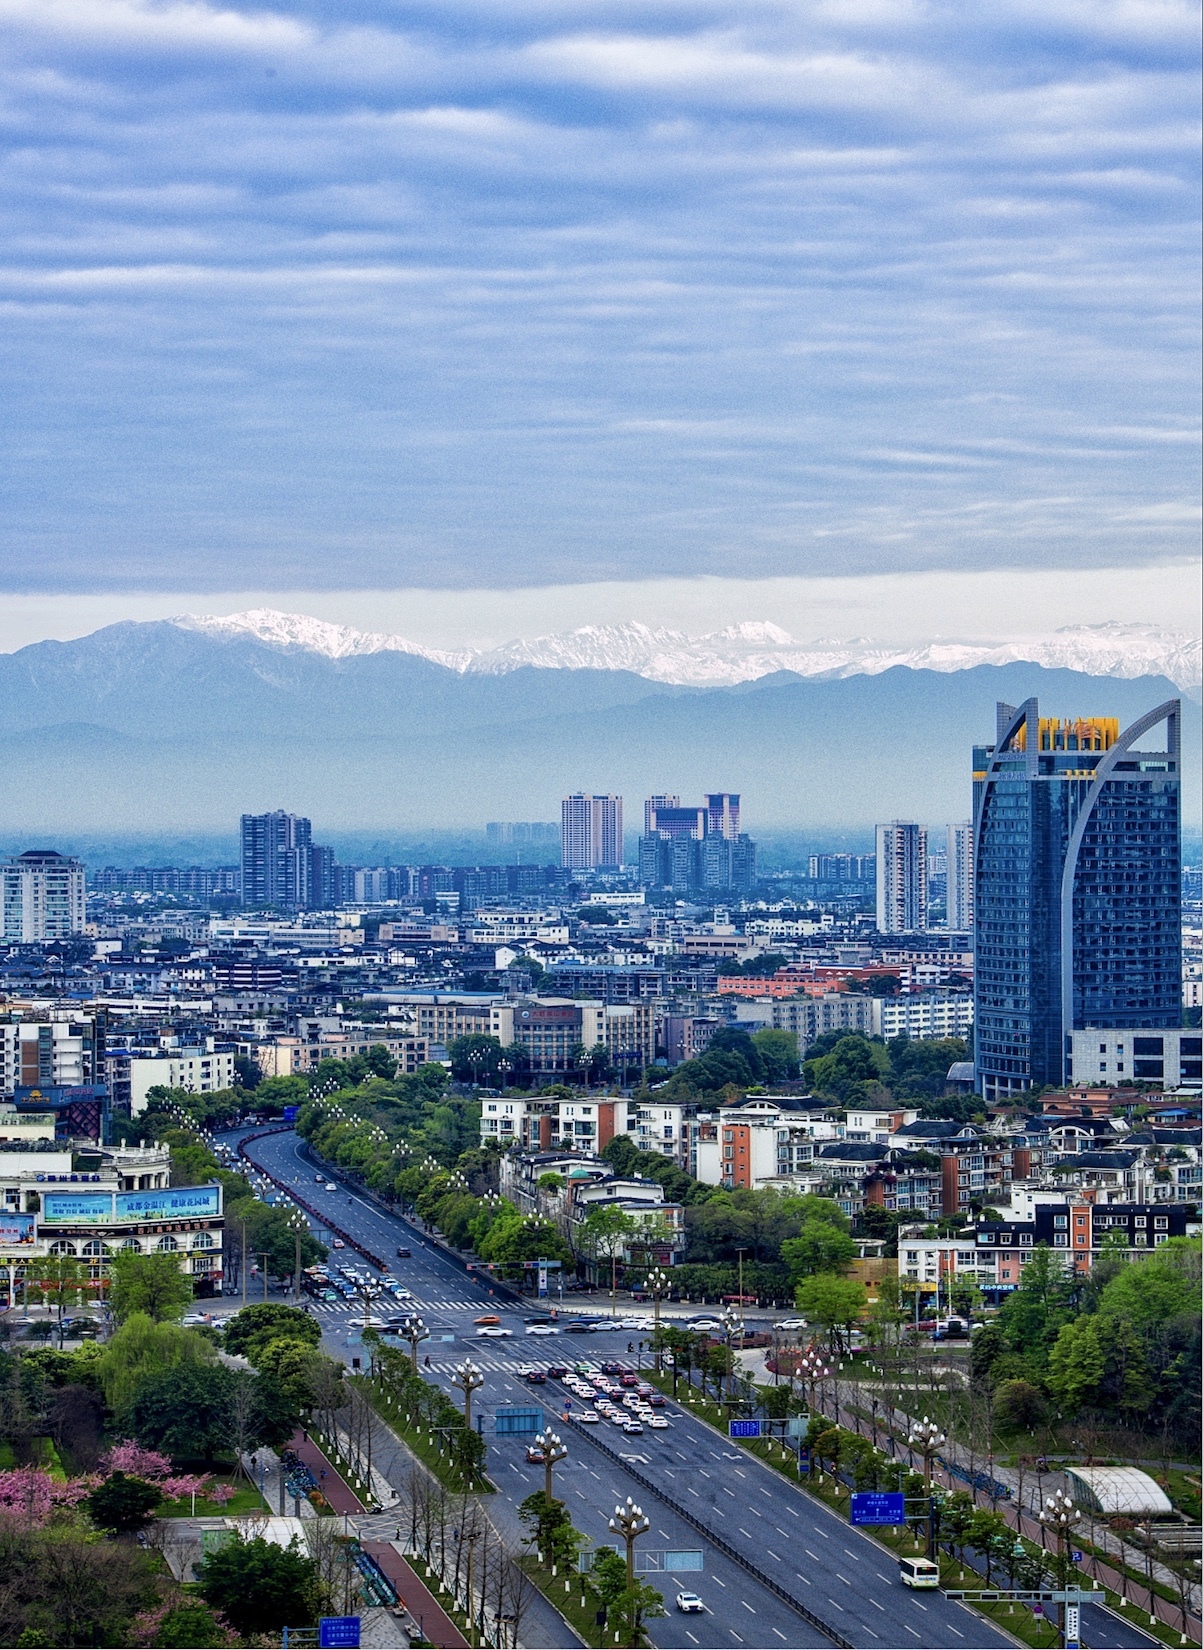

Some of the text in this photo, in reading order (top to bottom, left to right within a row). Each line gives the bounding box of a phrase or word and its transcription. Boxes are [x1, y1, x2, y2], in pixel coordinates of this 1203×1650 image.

[127, 1197, 210, 1211] 成都金温江 健康花园城
